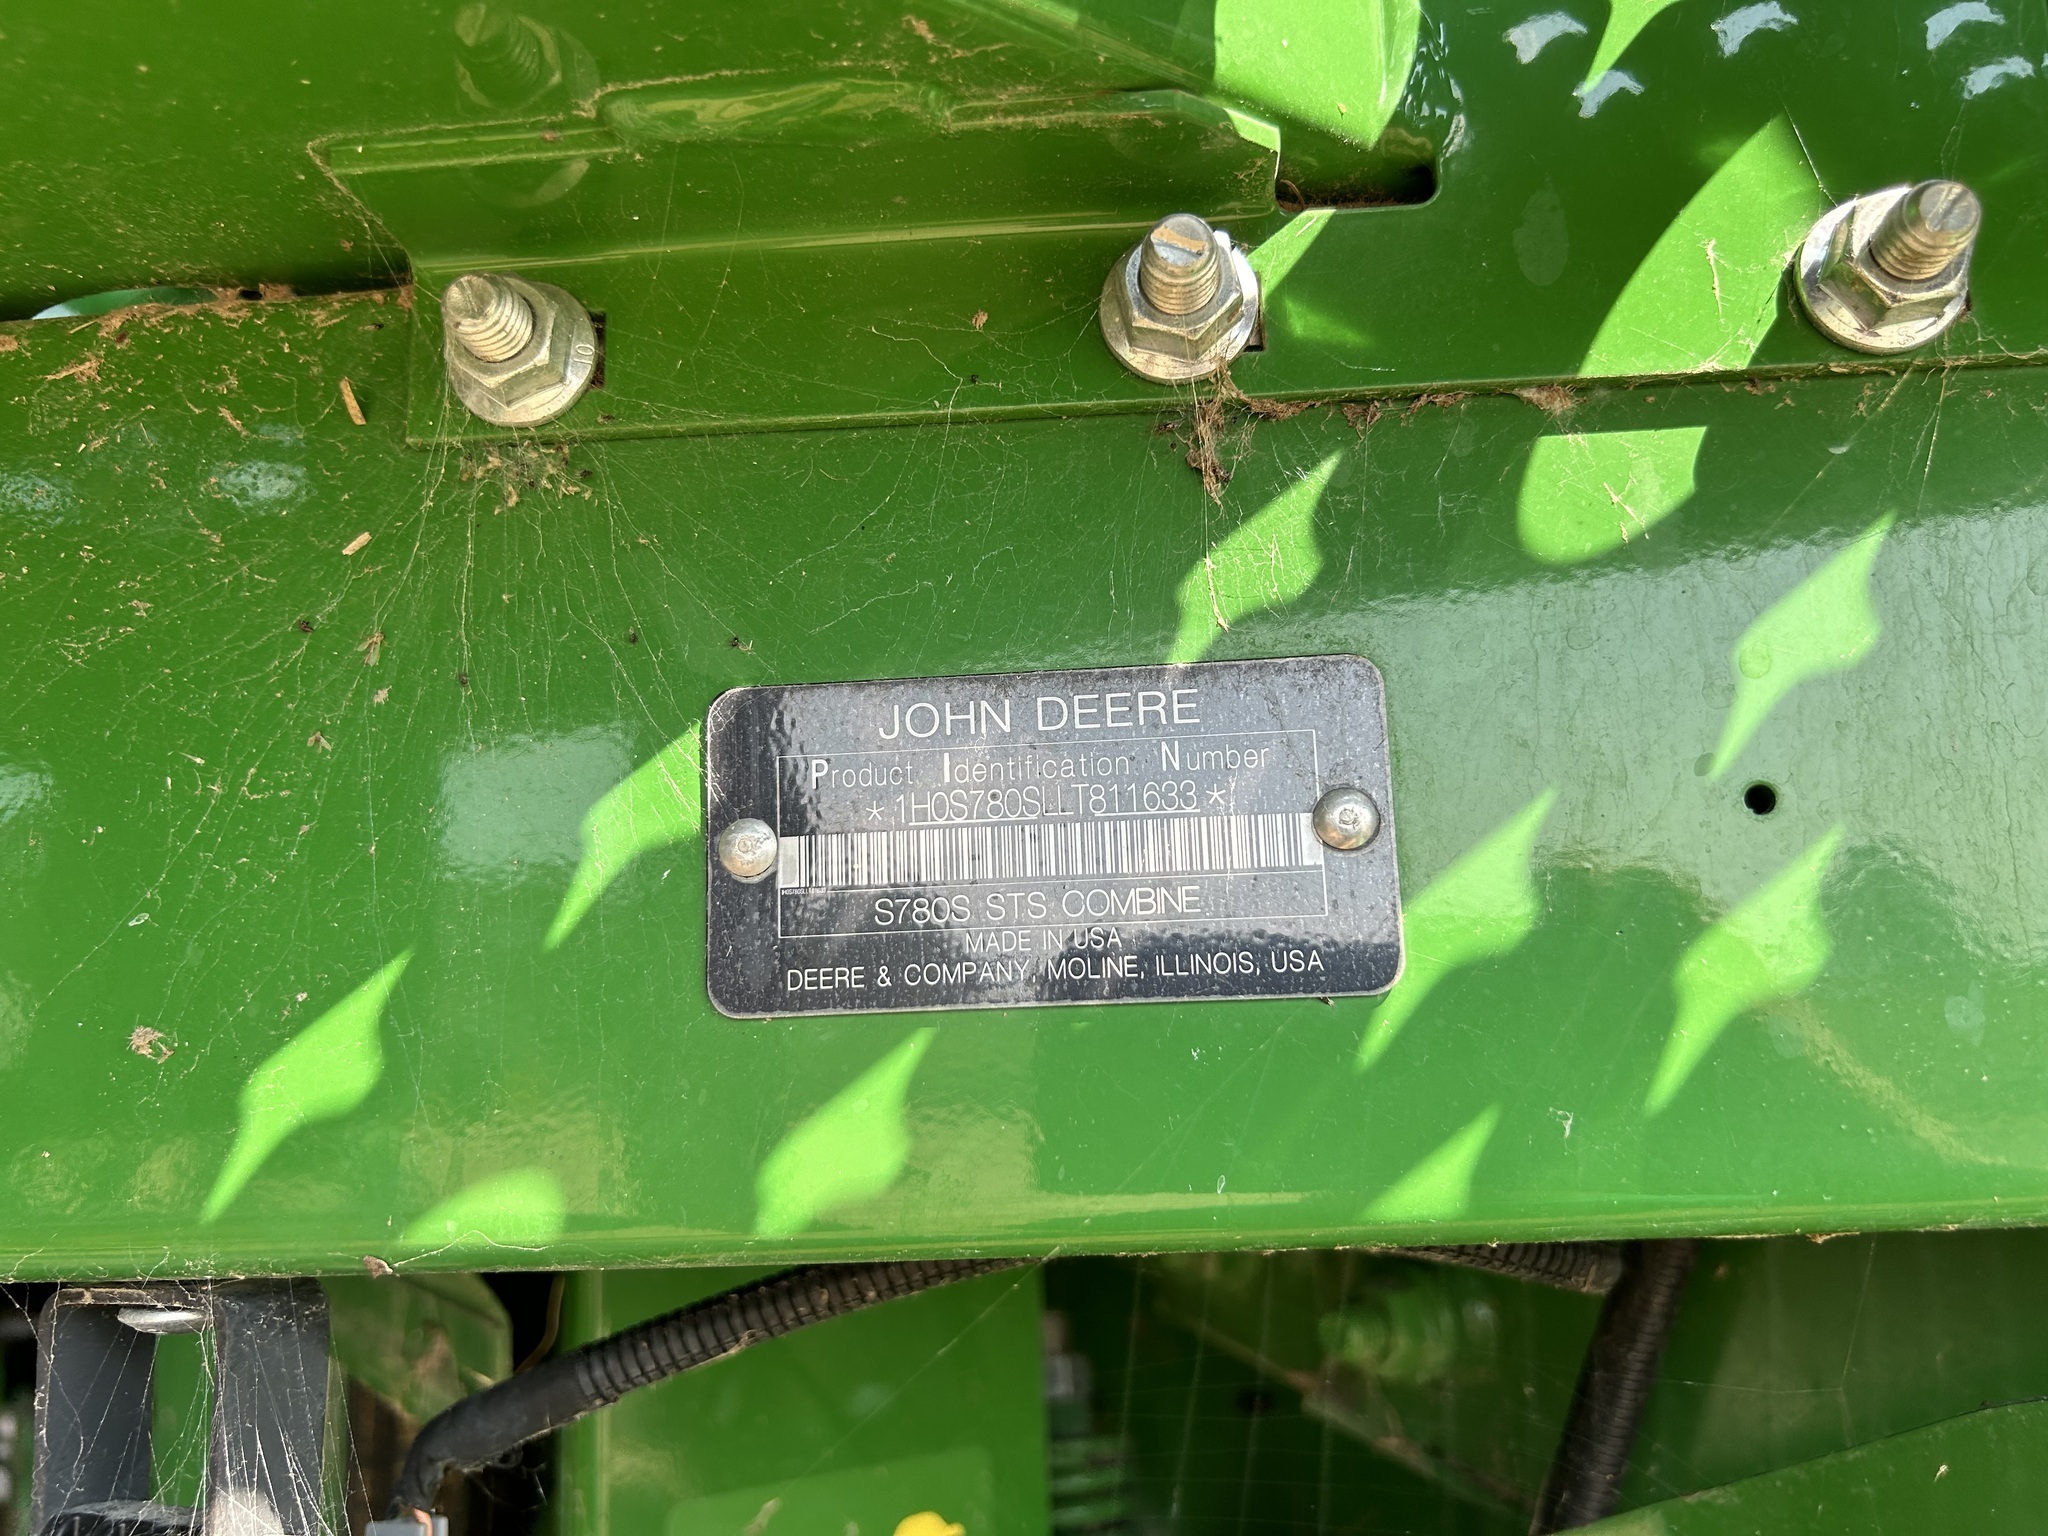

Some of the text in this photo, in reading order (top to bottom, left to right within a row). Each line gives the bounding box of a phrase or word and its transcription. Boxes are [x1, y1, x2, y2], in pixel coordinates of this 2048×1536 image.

[878, 688, 1200, 740] JOHN DEERE
[811, 741, 1270, 790] Product Identification Number
[896, 779, 1197, 823] 1H0S780SLLT811633
[874, 885, 1201, 926] S780S STS COMBINE
[965, 926, 1122, 953] MADE IN USA
[786, 949, 1325, 991] DEERE & COMPANY, MOLINE, ILLINOIS, USA
